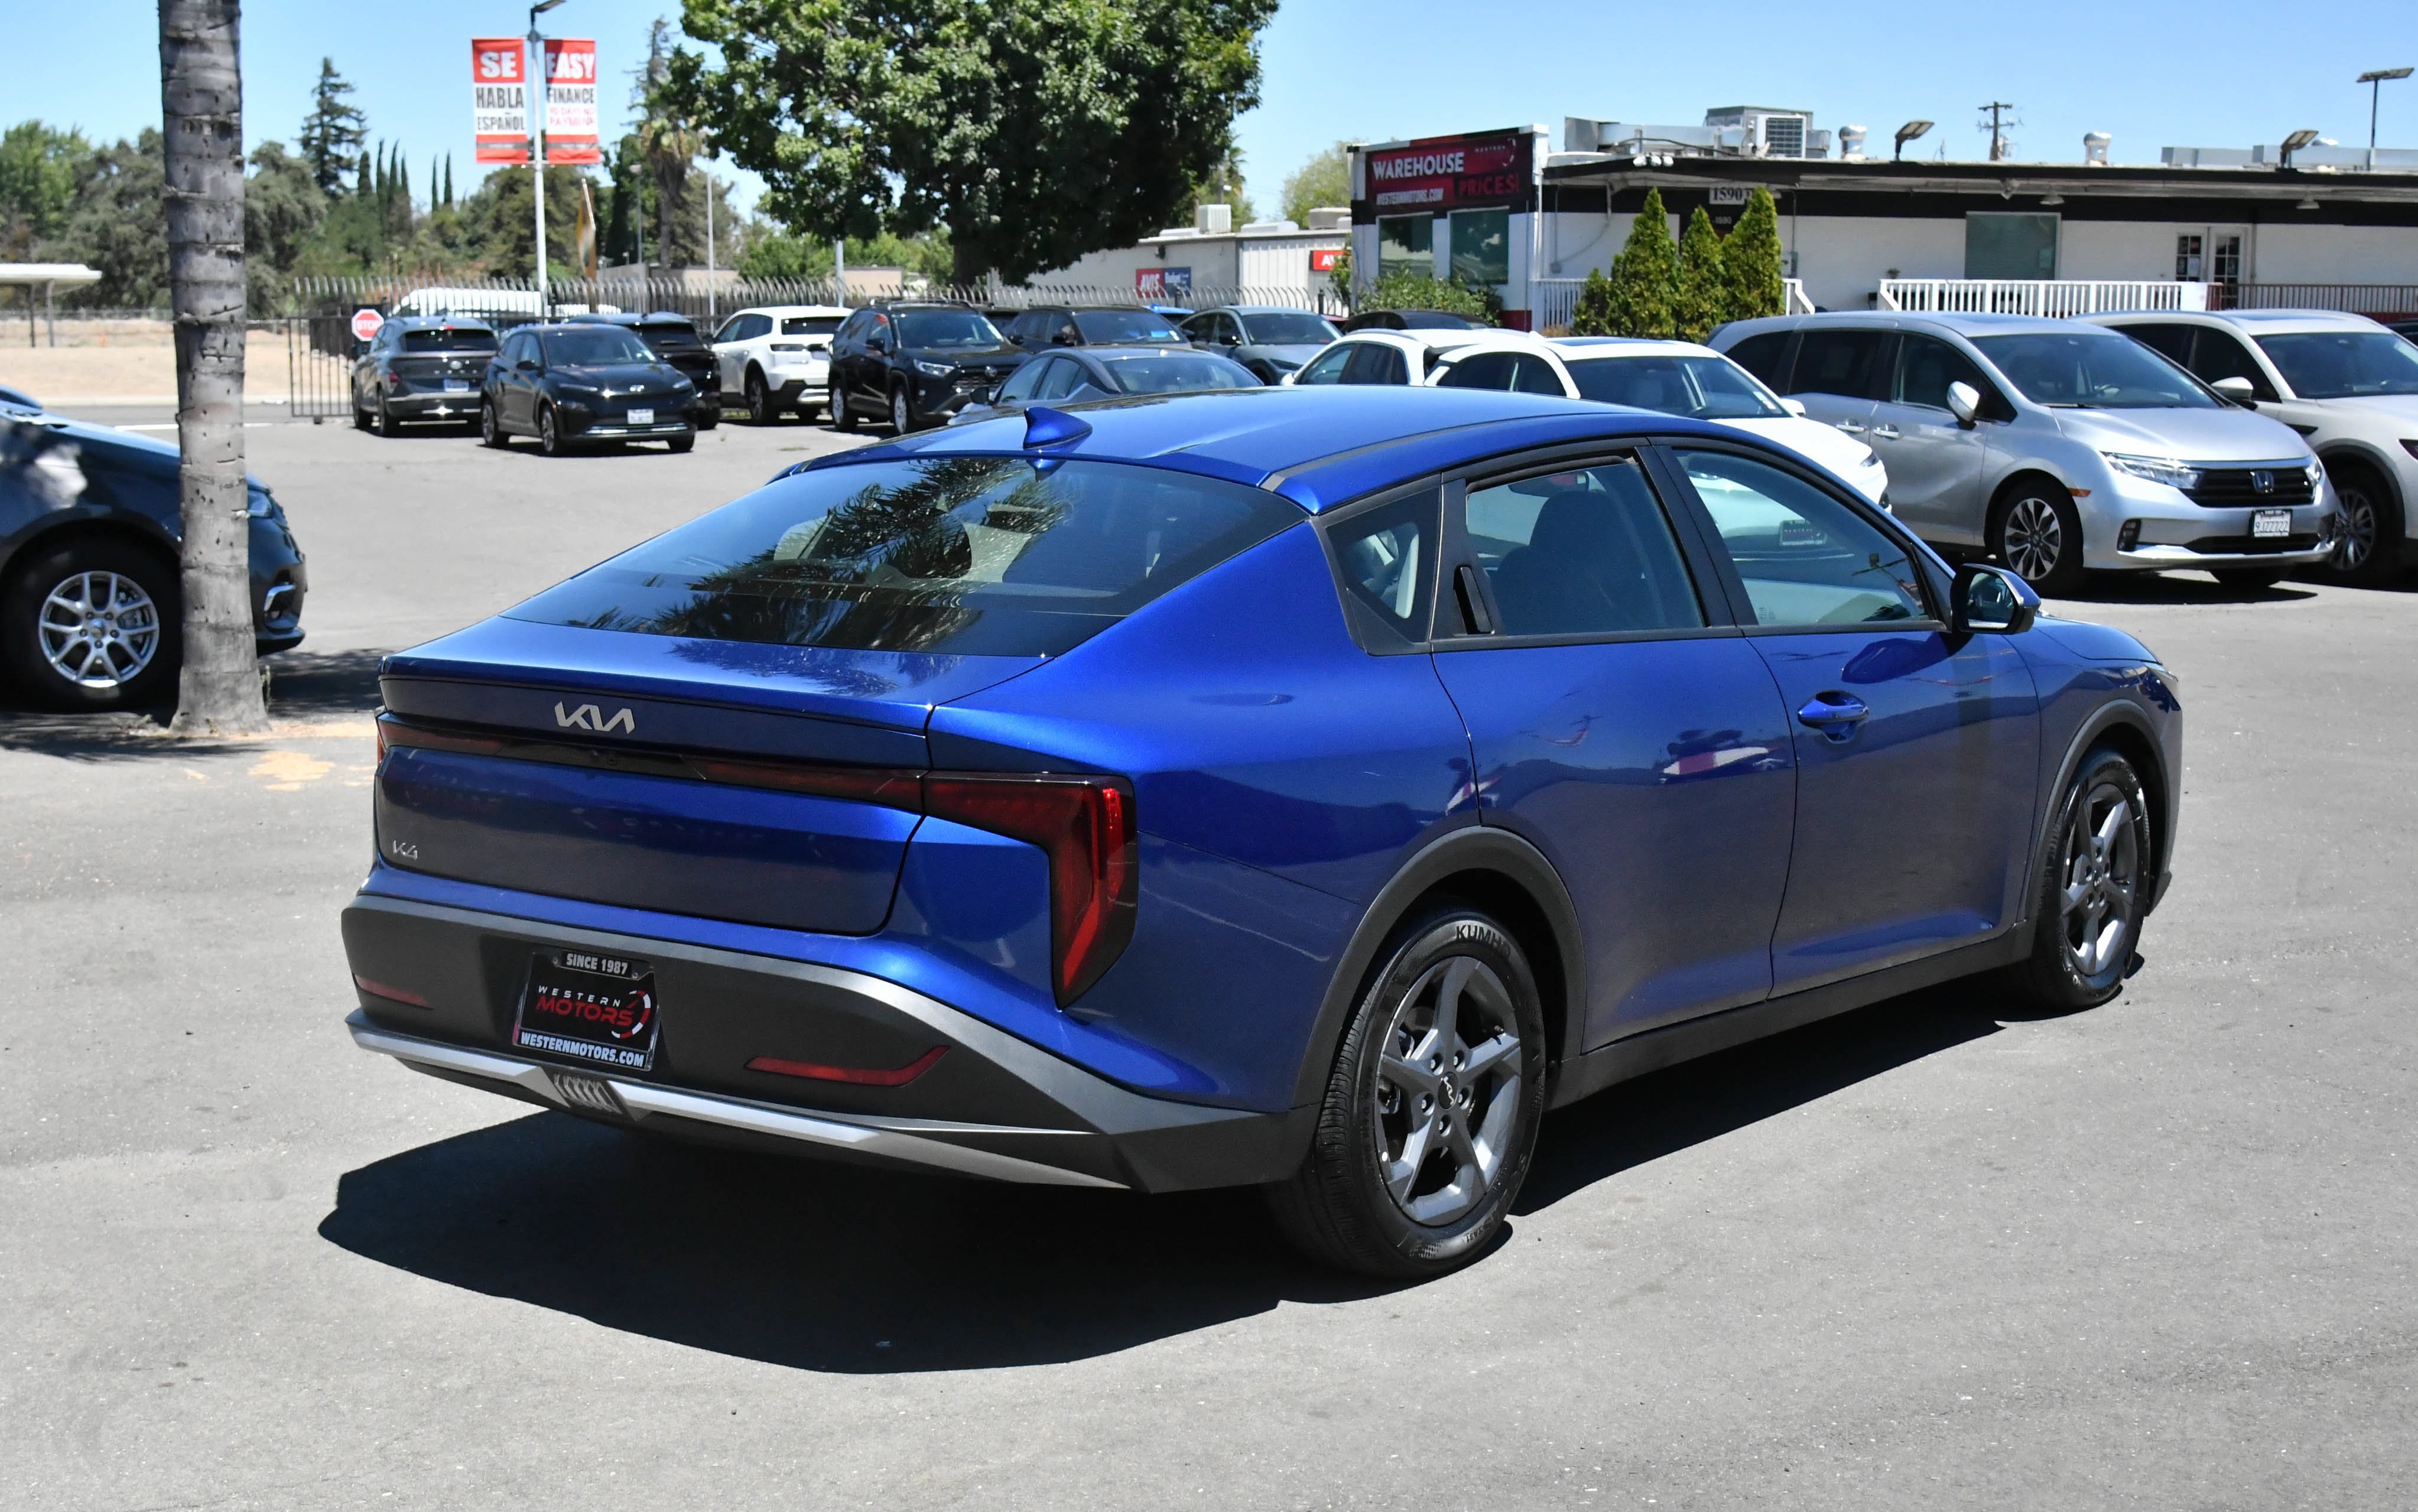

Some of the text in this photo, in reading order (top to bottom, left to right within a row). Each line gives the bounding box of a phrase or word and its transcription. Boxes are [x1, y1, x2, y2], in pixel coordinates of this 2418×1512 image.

[480, 51, 517, 78] SE
[546, 52, 595, 79] EASY
[476, 87, 524, 109] HABLA
[547, 88, 594, 103] FINANCE
[477, 112, 525, 131] ESPAÑOL
[1372, 152, 1464, 180] WAREHOUSE
[1714, 187, 1742, 201] 1590
[356, 319, 381, 331] STOP
[554, 701, 635, 734] KIA
[392, 840, 418, 860] K4
[566, 953, 628, 974] SINCE 1987
[538, 985, 620, 1007] WESTERN
[536, 995, 635, 1026] MOTORS
[521, 1032, 645, 1067] WESTERNMOTORS.COM
